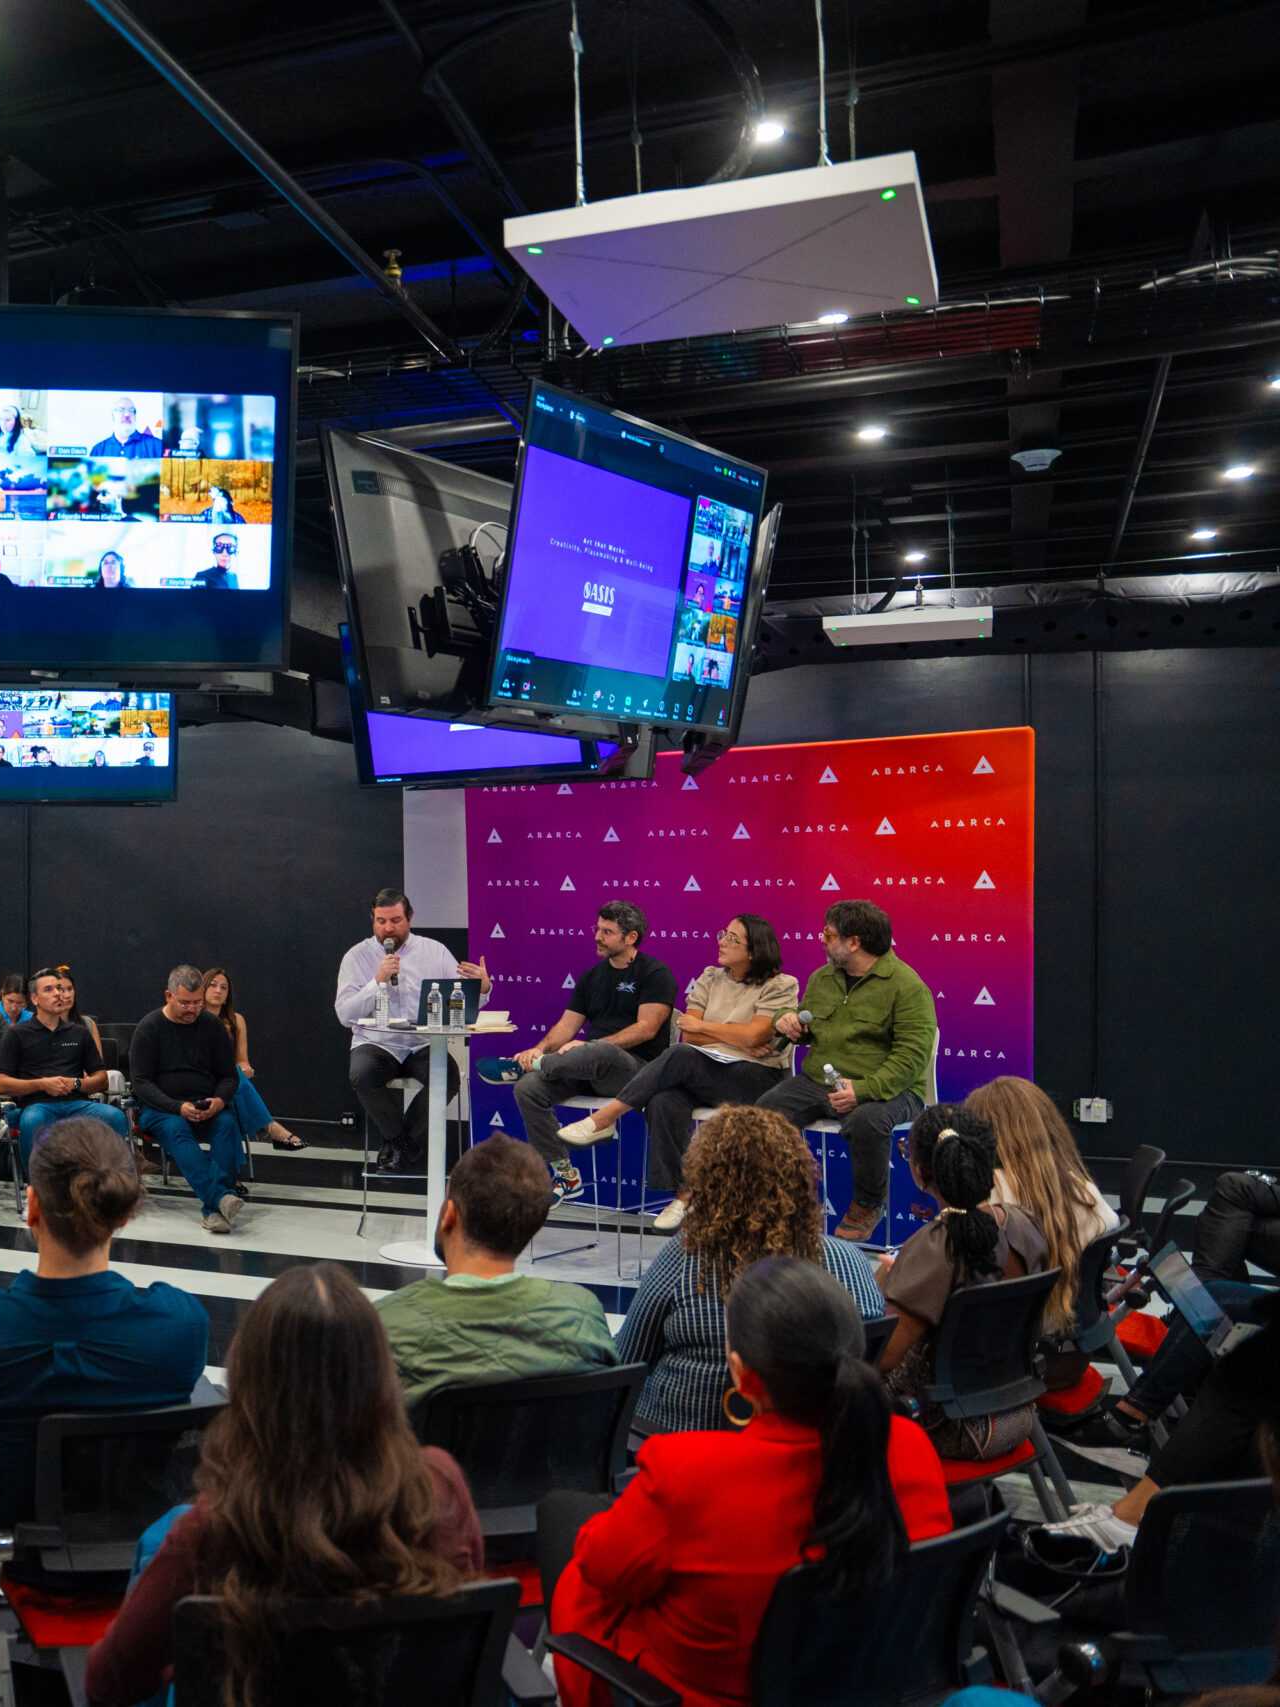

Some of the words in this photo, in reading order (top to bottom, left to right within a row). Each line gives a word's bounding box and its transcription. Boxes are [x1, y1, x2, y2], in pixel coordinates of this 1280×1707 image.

[594, 540, 607, 550] that
[583, 581, 616, 605] OASIS
[872, 764, 944, 776] ABARCA
[729, 774, 793, 784] ABARCA
[600, 781, 658, 789] ABARCA
[930, 818, 1006, 828] ABARCA
[648, 829, 709, 837] ABARCA
[782, 824, 849, 833] ABARCA
[527, 831, 582, 839] ABARCA
[731, 879, 795, 887] ABARCA
[873, 876, 945, 885] ABARCA
[530, 928, 585, 936] ABARCA
[649, 930, 710, 939] ABARCA
[931, 934, 1006, 942] ABARCA
[489, 974, 542, 983] ABARCA
[935, 1048, 1006, 1059] BARCA
